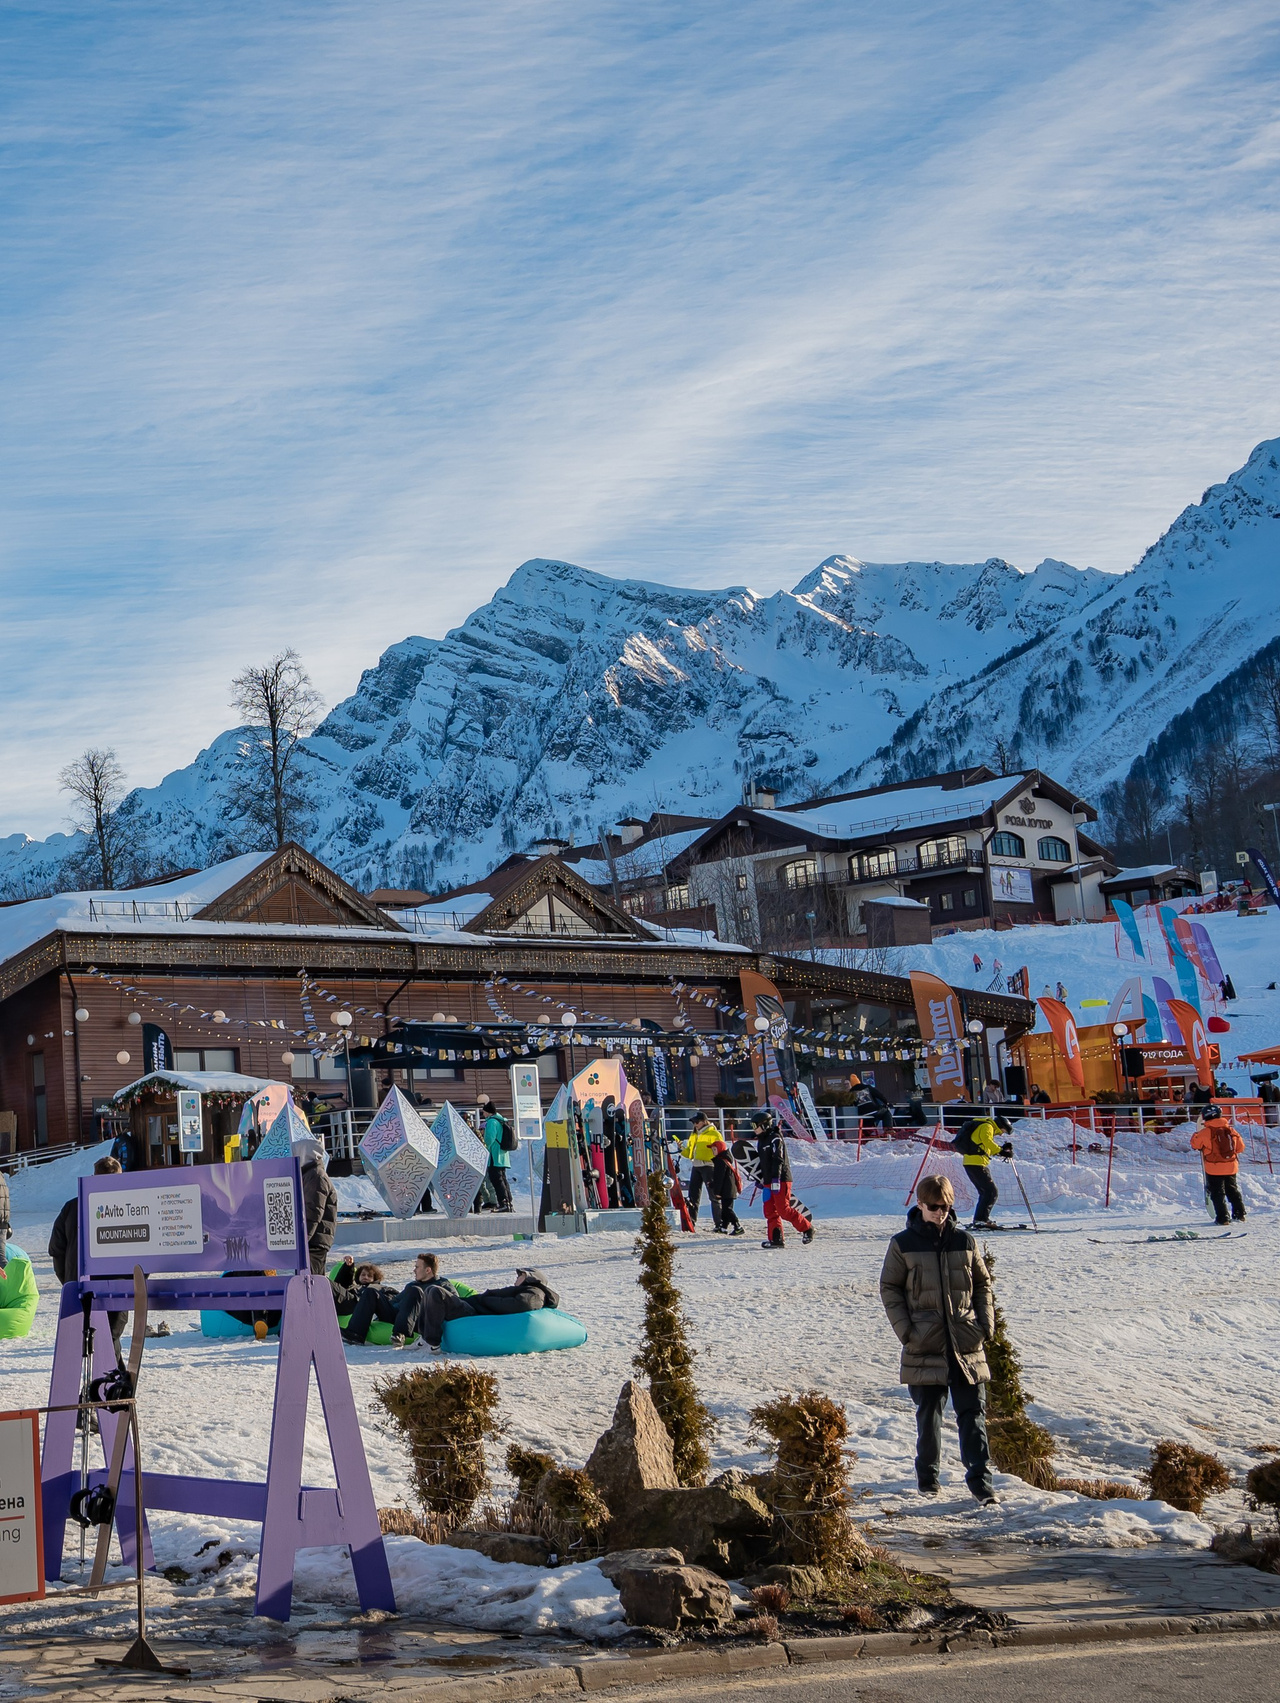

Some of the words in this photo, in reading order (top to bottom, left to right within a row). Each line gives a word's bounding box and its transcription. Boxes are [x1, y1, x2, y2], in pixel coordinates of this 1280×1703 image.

[1005, 814, 1027, 827] РОЗА
[1027, 816, 1053, 830] ХУТОР
[631, 1037, 653, 1045] БЫТЬ
[151, 1041, 159, 1071] АКИМ
[1158, 1049, 1184, 1059] ГОДА
[658, 1056, 668, 1087] БОКАЛ
[104, 1204, 125, 1218] Avito
[125, 1202, 150, 1217] Team
[99, 1229, 133, 1240] MOUNTAIN
[133, 1228, 147, 1238] HUB
[269, 1238, 295, 1246] rosafest.ru
